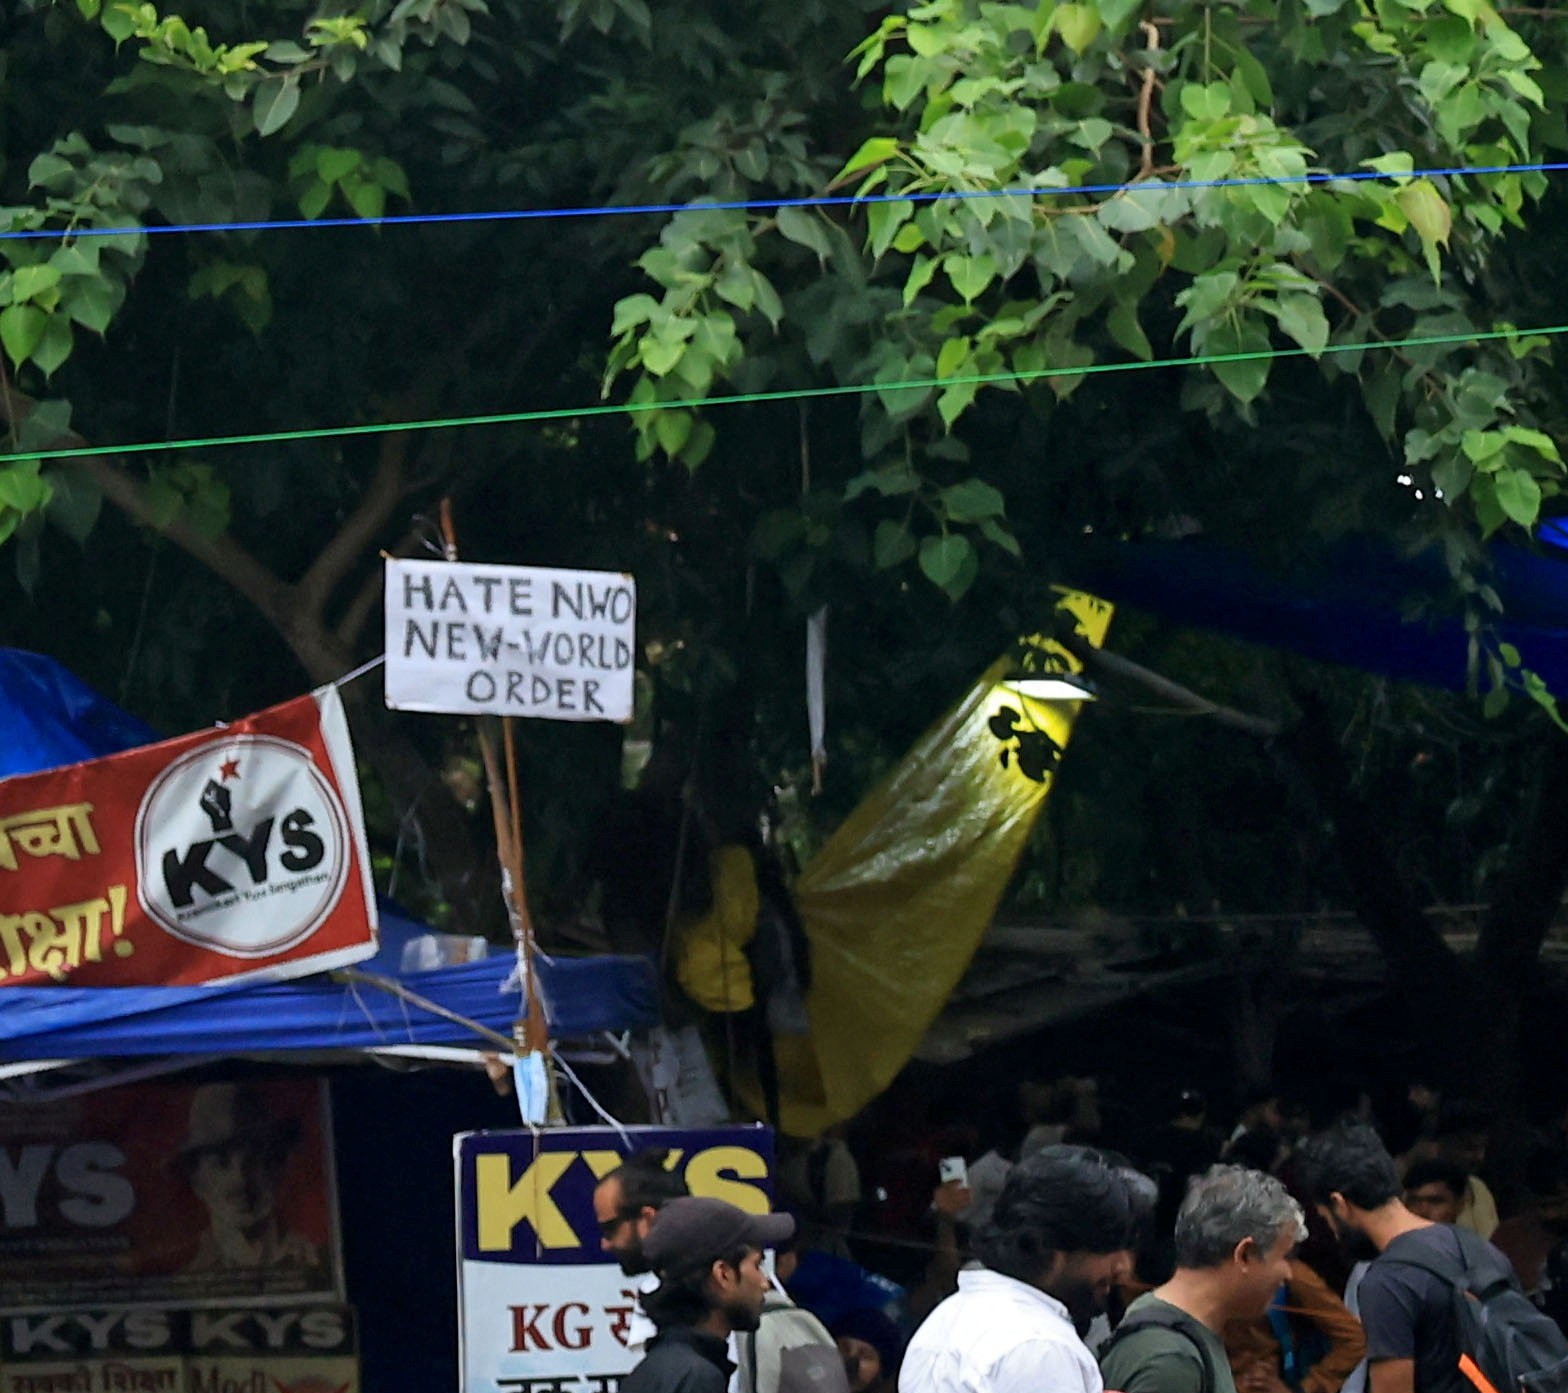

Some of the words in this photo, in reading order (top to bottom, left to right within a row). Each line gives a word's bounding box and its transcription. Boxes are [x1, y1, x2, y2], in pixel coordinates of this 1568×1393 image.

[403, 574, 532, 616] HATE
[552, 581, 632, 624] NWO
[404, 618, 631, 670] NEW-WORLD
[466, 669, 604, 713] ORDER
[162, 808, 324, 910] KYS
[0, 1141, 138, 1228] YS
[10, 1311, 172, 1354] KYS
[190, 1310, 347, 1352] KYS
[507, 1302, 594, 1353] KG
